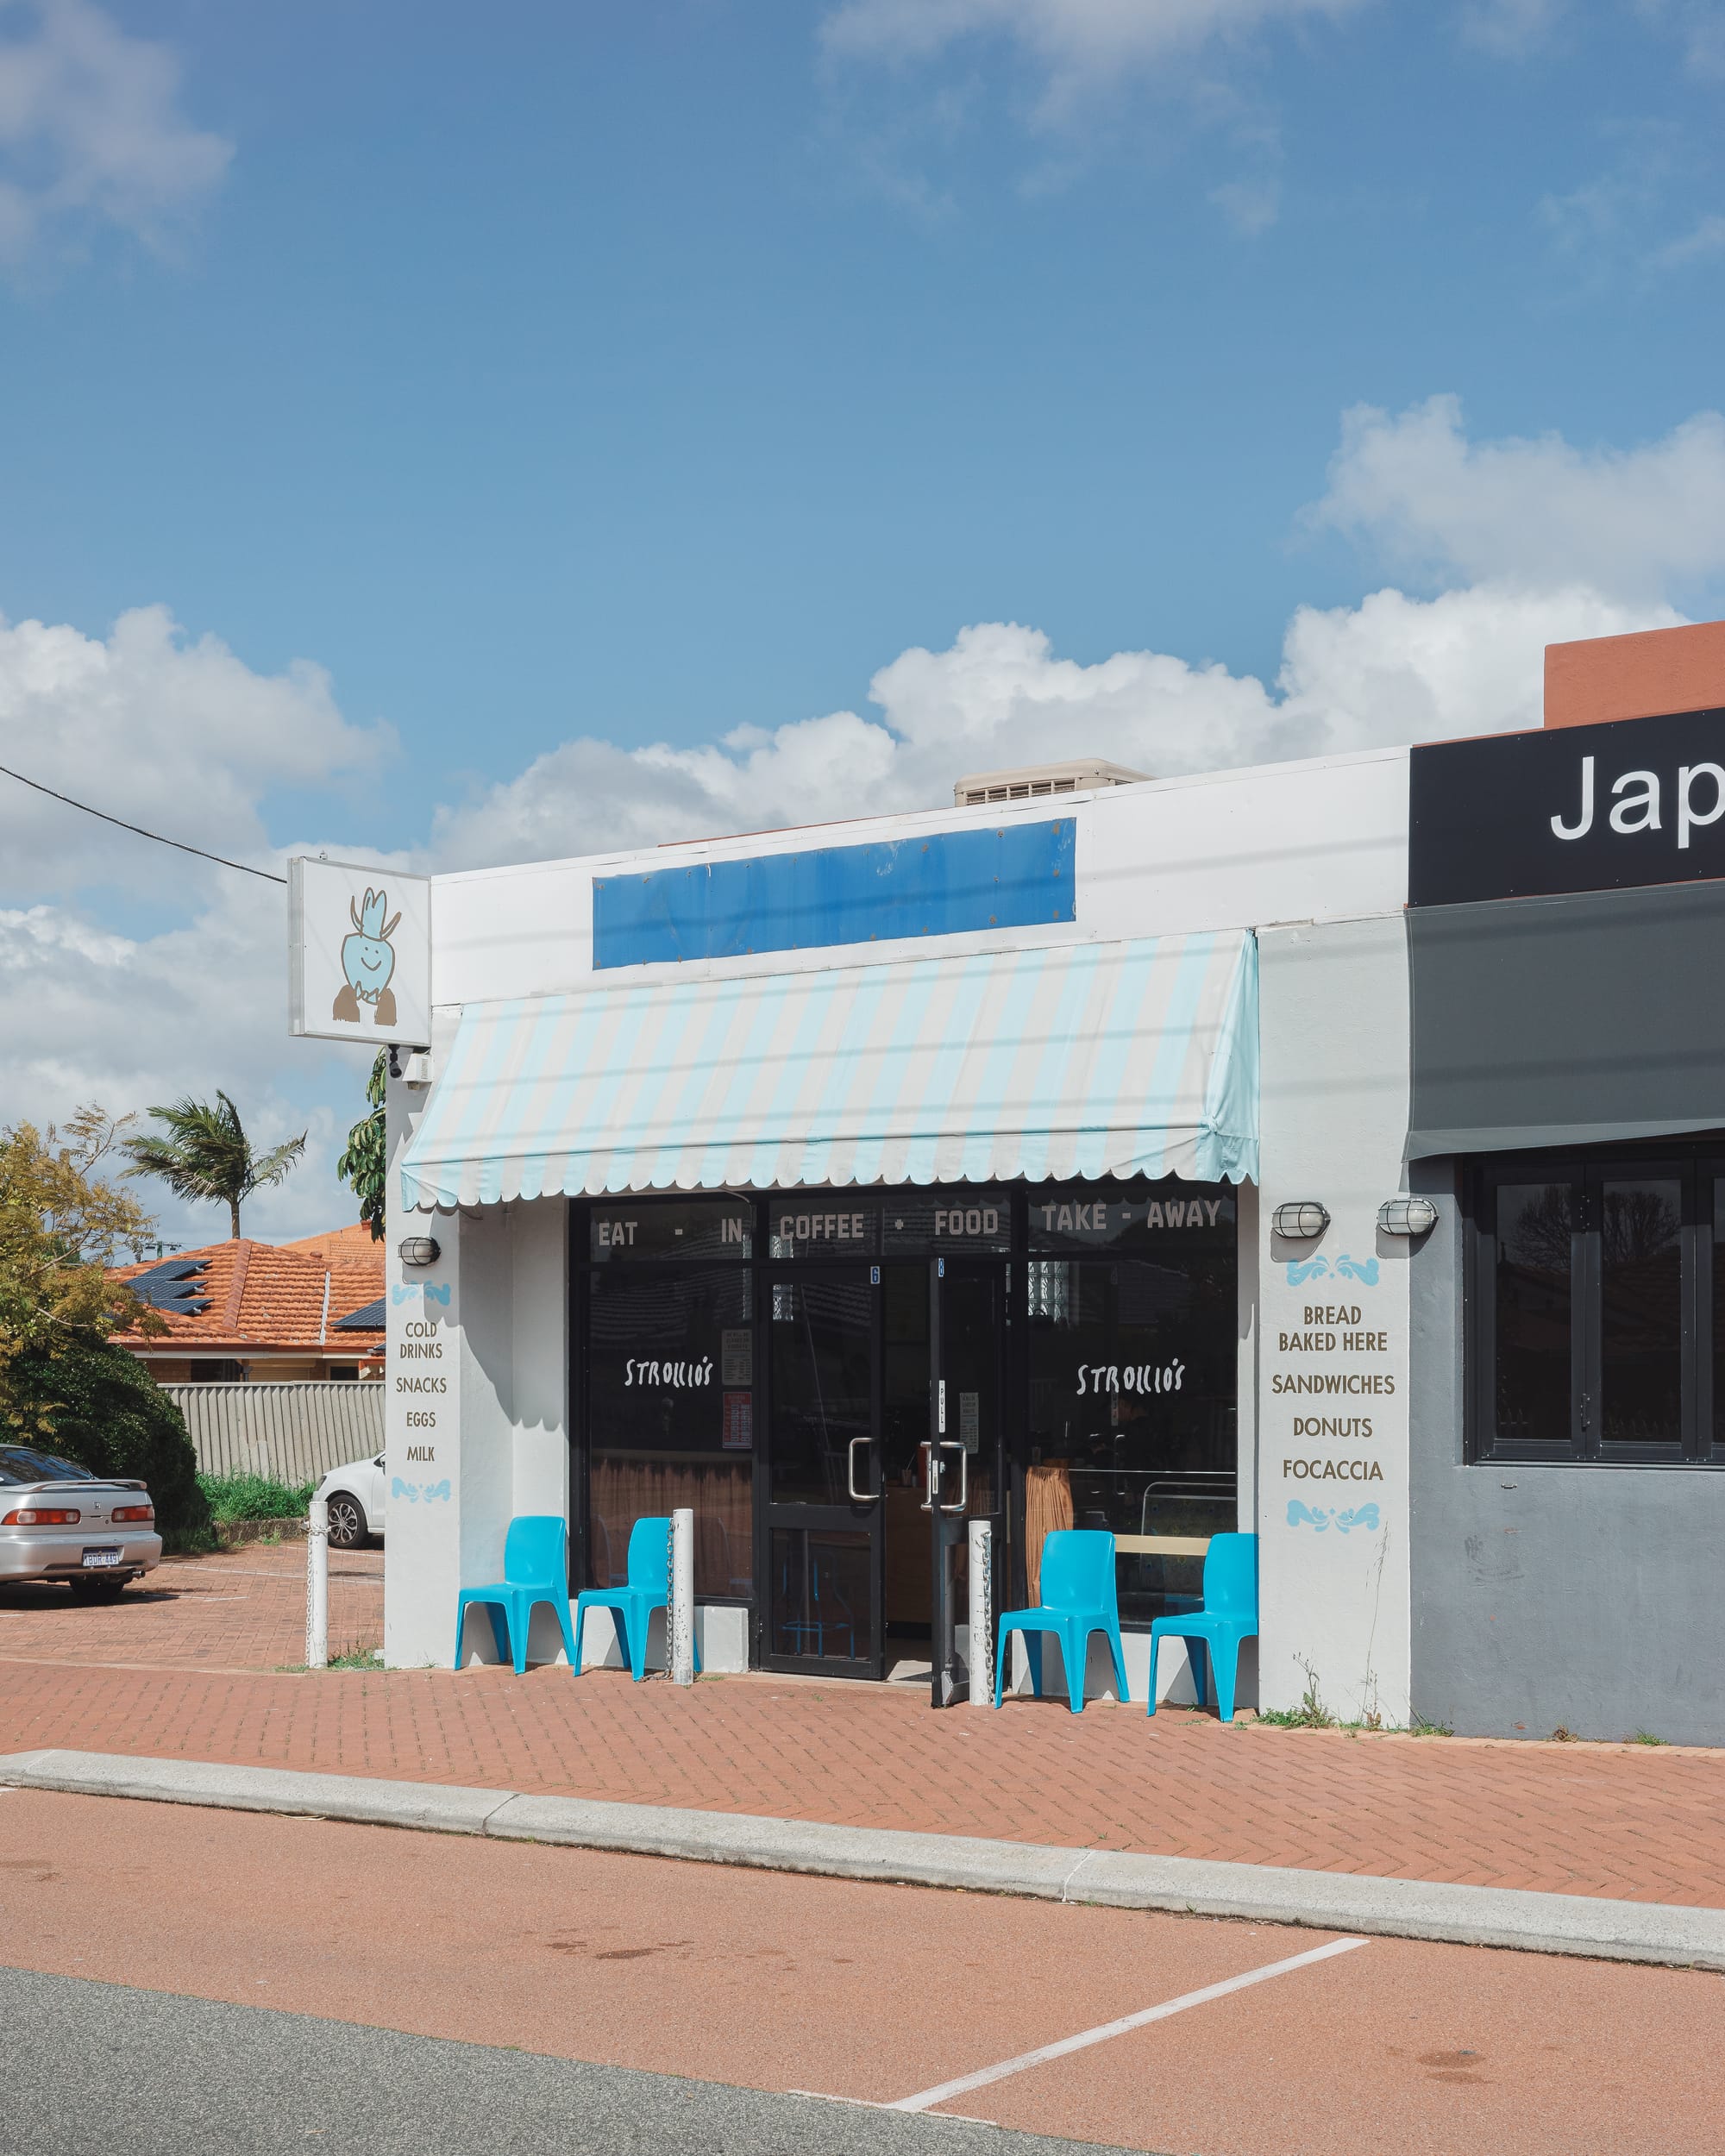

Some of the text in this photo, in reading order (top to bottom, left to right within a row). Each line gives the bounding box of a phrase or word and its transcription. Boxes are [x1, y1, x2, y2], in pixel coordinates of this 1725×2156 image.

[1550, 755, 1725, 849] Jap
[780, 1208, 999, 1240] COFFEE FOOD
[1041, 1204, 1107, 1232] TAKE
[1146, 1200, 1222, 1228] AWAY
[599, 1221, 637, 1246] EAT
[721, 1218, 743, 1243] IN
[872, 1267, 879, 1283] 6
[938, 1259, 944, 1276] 8
[1303, 1305, 1362, 1326] BREAD
[405, 1321, 438, 1338] COLD
[399, 1342, 443, 1360] DRINKS
[1278, 1332, 1388, 1352] BAKED HERE
[396, 1376, 447, 1394] SNACKS
[1271, 1373, 1396, 1395] SANDWICHES
[406, 1411, 436, 1428] EGGS
[1293, 1417, 1373, 1438] DONUTS
[406, 1445, 436, 1463] MILK
[1283, 1459, 1384, 1481] FOCACCIA
